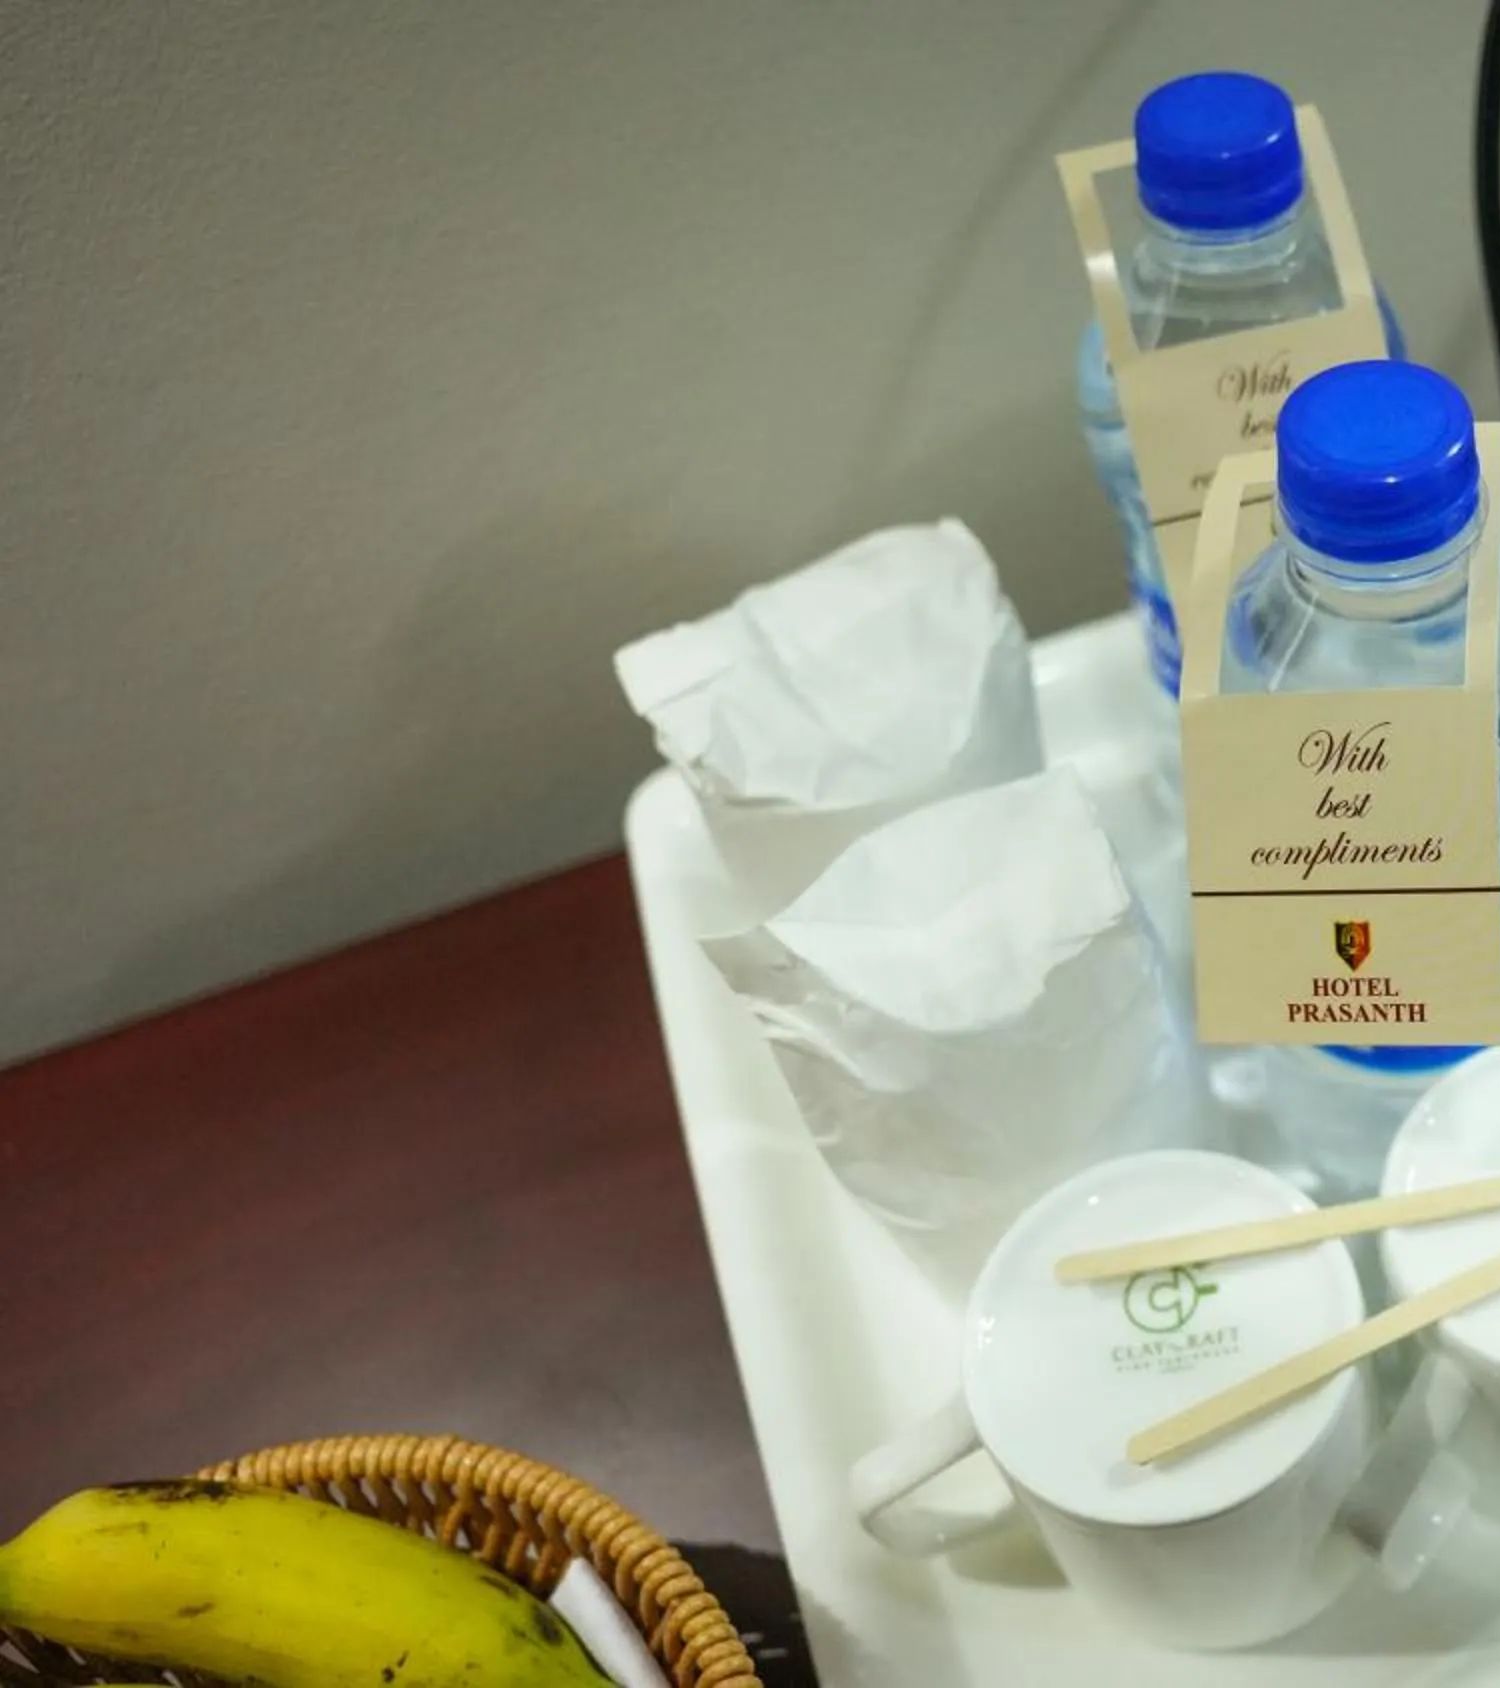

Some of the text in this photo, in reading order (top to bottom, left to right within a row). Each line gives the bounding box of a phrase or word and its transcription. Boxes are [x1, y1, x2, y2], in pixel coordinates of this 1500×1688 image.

[1216, 350, 1292, 403] With
[1240, 410, 1276, 439] bes
[1298, 721, 1392, 776] With
[1315, 786, 1373, 819] best
[1250, 831, 1444, 880] compliments
[1311, 976, 1400, 998] HOTEL
[1287, 1002, 1427, 1024] PRASANTH
